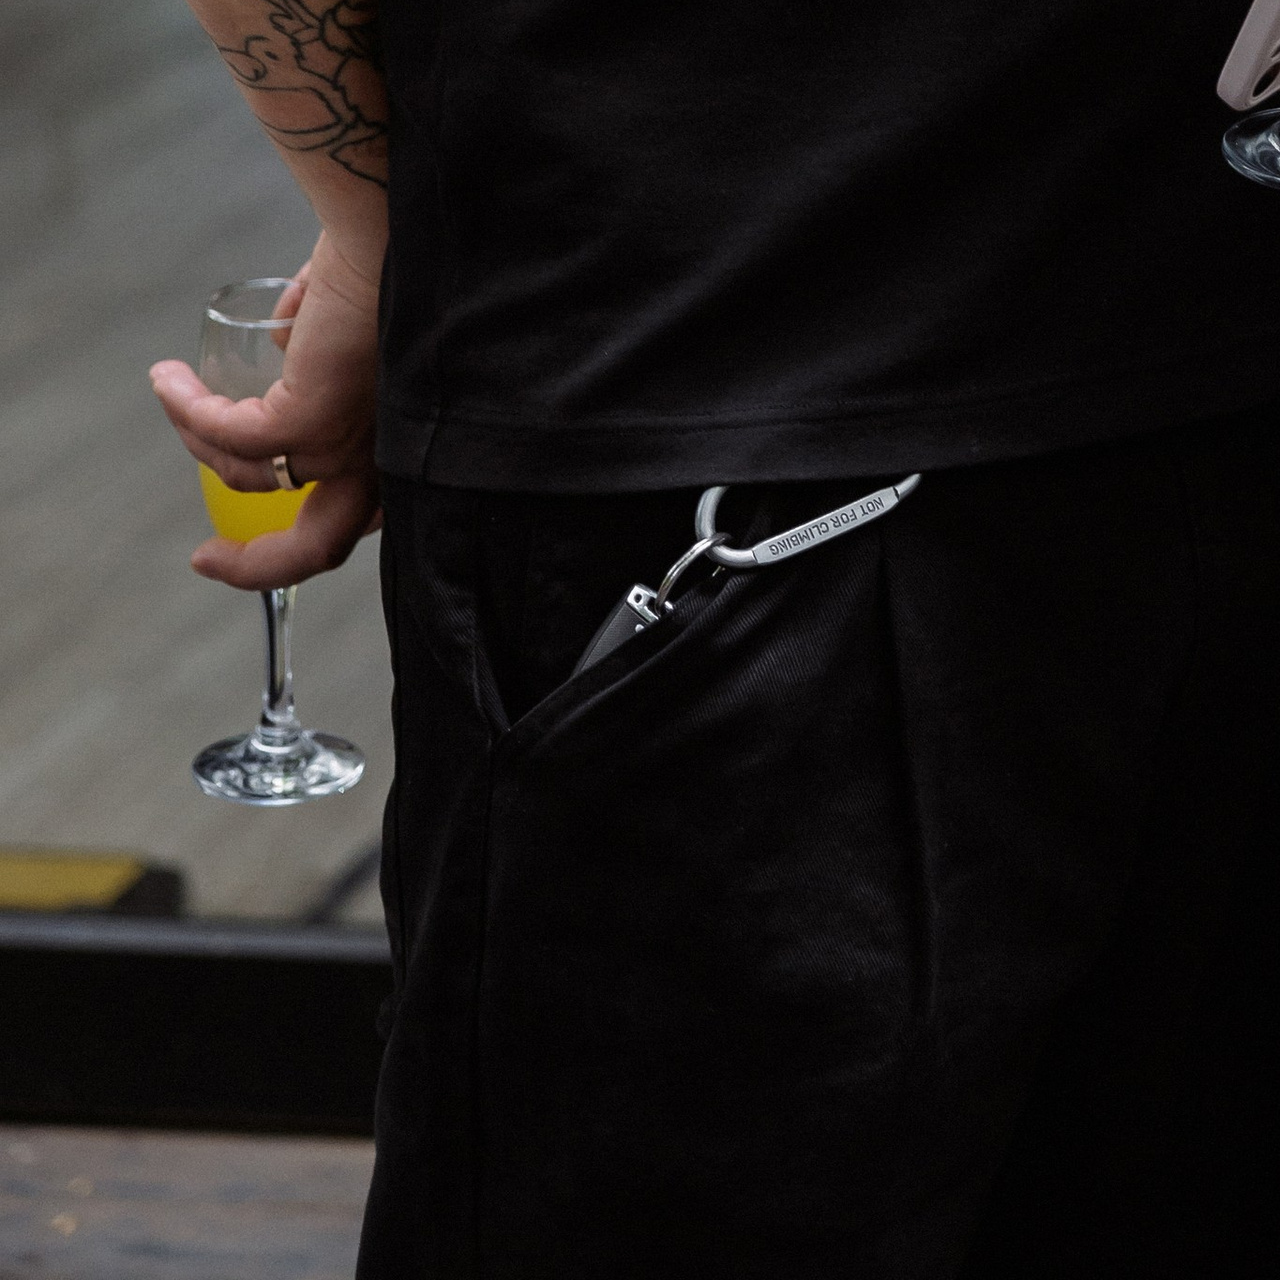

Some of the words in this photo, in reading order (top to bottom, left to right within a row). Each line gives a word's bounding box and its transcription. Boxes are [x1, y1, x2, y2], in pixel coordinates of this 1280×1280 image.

[860, 496, 885, 517] NOT
[830, 508, 858, 528] FOR
[768, 521, 830, 556] CLIMBING
